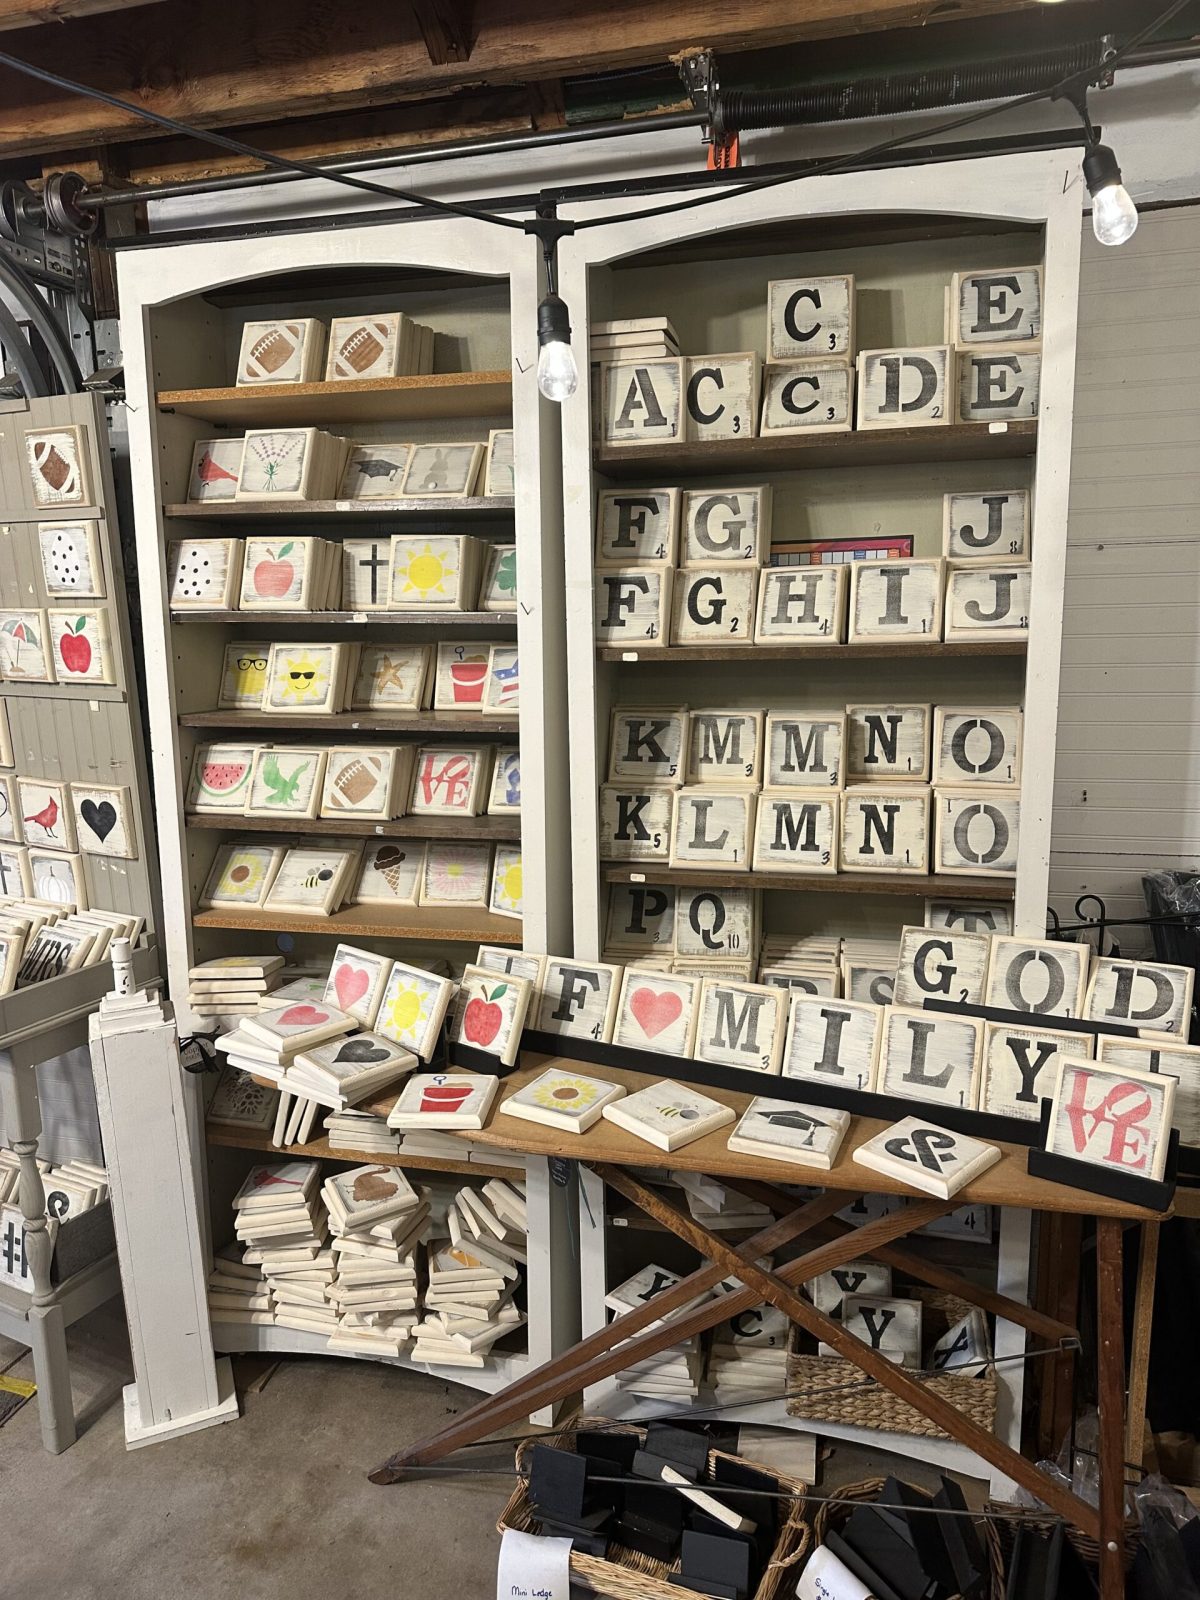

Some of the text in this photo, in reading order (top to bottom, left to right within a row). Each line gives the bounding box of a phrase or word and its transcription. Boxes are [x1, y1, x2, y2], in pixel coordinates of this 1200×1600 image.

[784, 288, 822, 342] C
[971, 276, 1024, 333] E
[615, 368, 668, 429] A
[687, 367, 726, 425] C
[879, 356, 938, 414] D
[970, 356, 1025, 409] E
[611, 497, 660, 548] F
[694, 495, 747, 553] G
[959, 496, 1009, 547] J
[601, 575, 651, 627] F
[686, 575, 727, 625] G
[770, 574, 824, 625] H
[878, 567, 911, 625] I
[964, 573, 1018, 622] J
[621, 719, 671, 763] K
[699, 718, 746, 765] M
[780, 723, 830, 773] M
[864, 714, 903, 764] N
[951, 719, 1006, 774] O
[614, 795, 651, 841] K
[688, 799, 730, 850] L
[769, 803, 822, 852] M
[858, 804, 901, 855] N
[953, 803, 1009, 864] O
[624, 888, 669, 934] P
[688, 892, 726, 950] Q
[913, 939, 957, 995] G
[1005, 949, 1065, 1014] O
[1104, 965, 1175, 1021] D
[551, 967, 600, 1023] F
[709, 990, 766, 1054] M
[813, 1008, 852, 1076] I
[902, 1020, 955, 1089] L
[1005, 1036, 1058, 1104] Y
[730, 1309, 763, 1338] C
[511, 1585, 528, 1596] Mini
